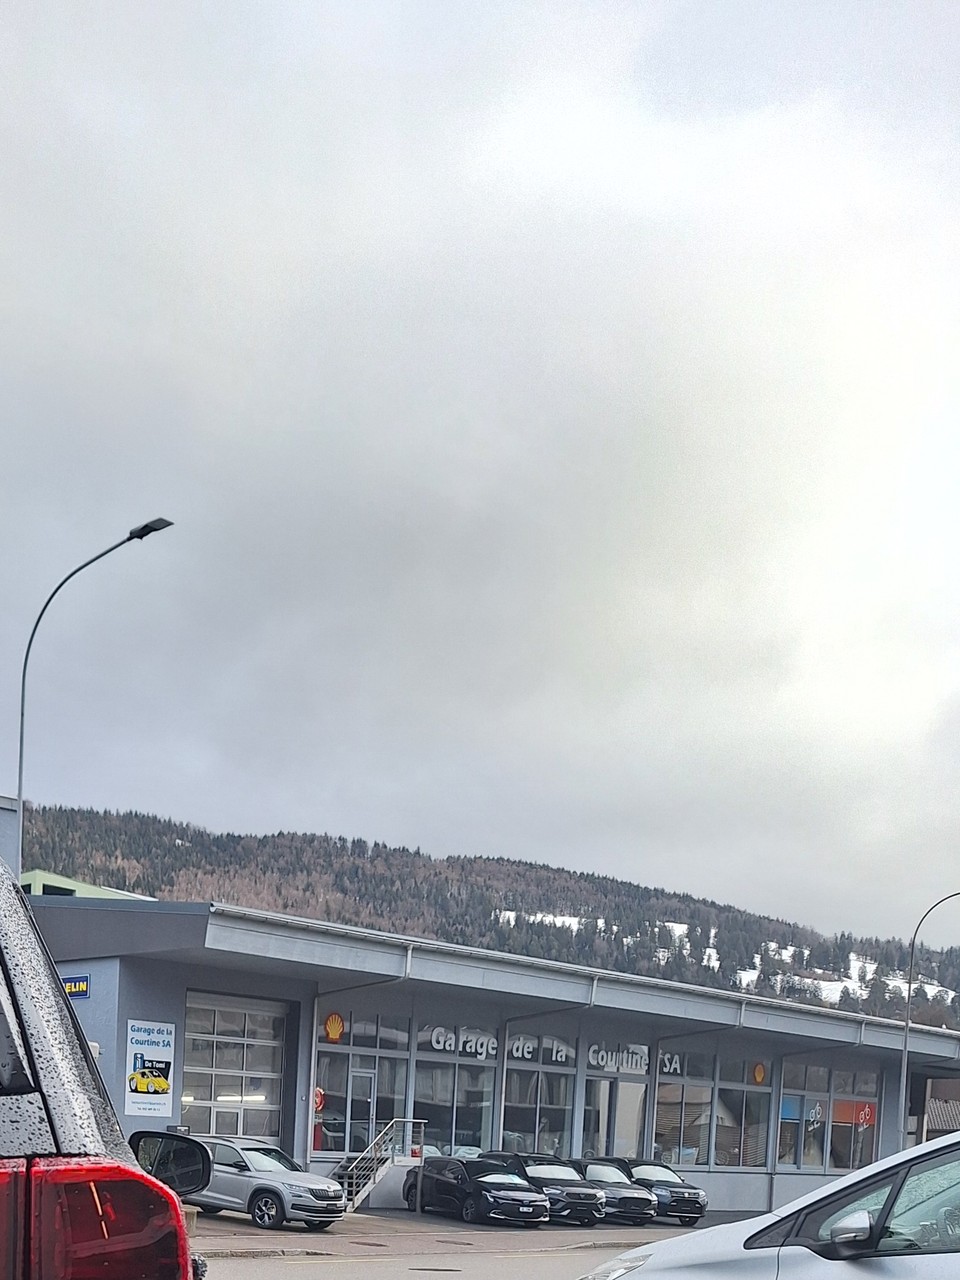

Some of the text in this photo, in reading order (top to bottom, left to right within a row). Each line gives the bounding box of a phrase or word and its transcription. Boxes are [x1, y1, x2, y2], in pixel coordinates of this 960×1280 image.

[65, 981, 87, 993] ELIN
[130, 1024, 172, 1036] Garage de la
[130, 1036, 171, 1048] Courtine SA
[431, 1026, 498, 1060] Garage
[512, 1036, 533, 1059] de
[552, 1040, 567, 1062] la
[662, 1053, 681, 1074] SA
